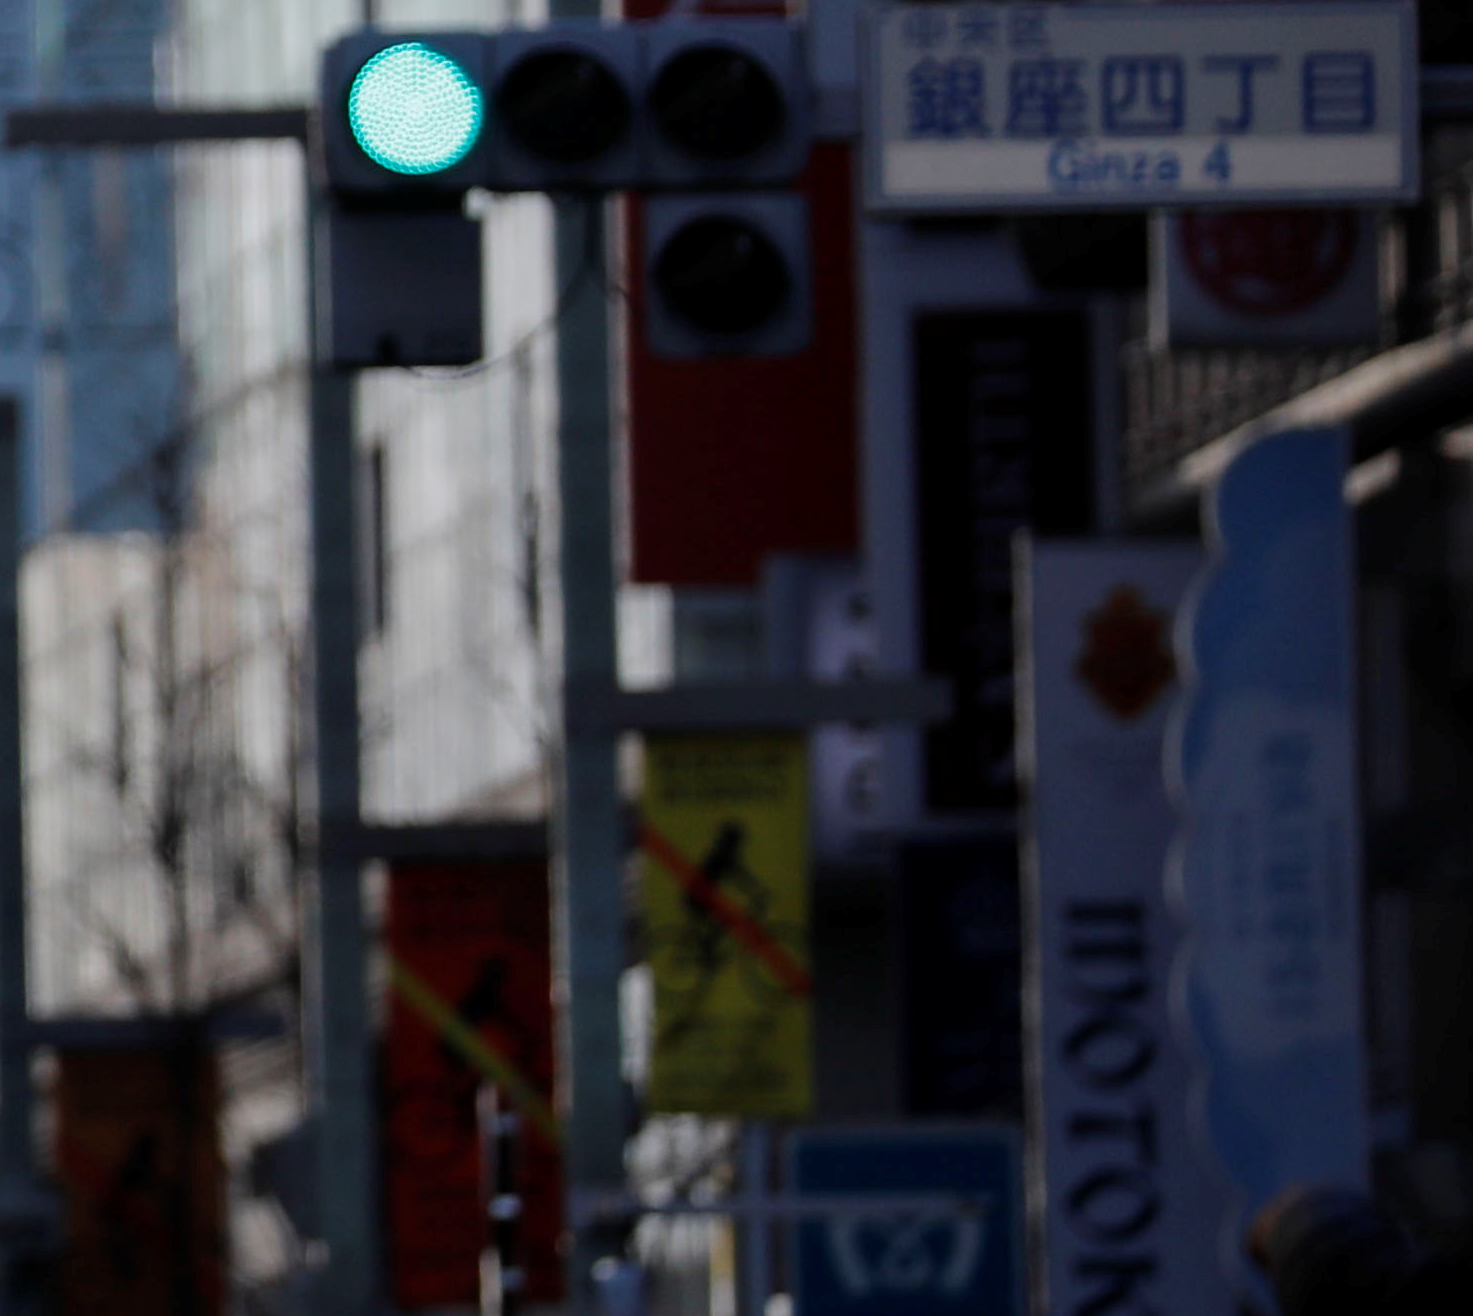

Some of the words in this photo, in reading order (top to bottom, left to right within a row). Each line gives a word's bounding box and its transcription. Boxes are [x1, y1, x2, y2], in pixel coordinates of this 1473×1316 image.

[905, 50, 1379, 139] 銀座四丁目
[1046, 139, 1180, 193] Ginza
[1202, 140, 1233, 187] 4
